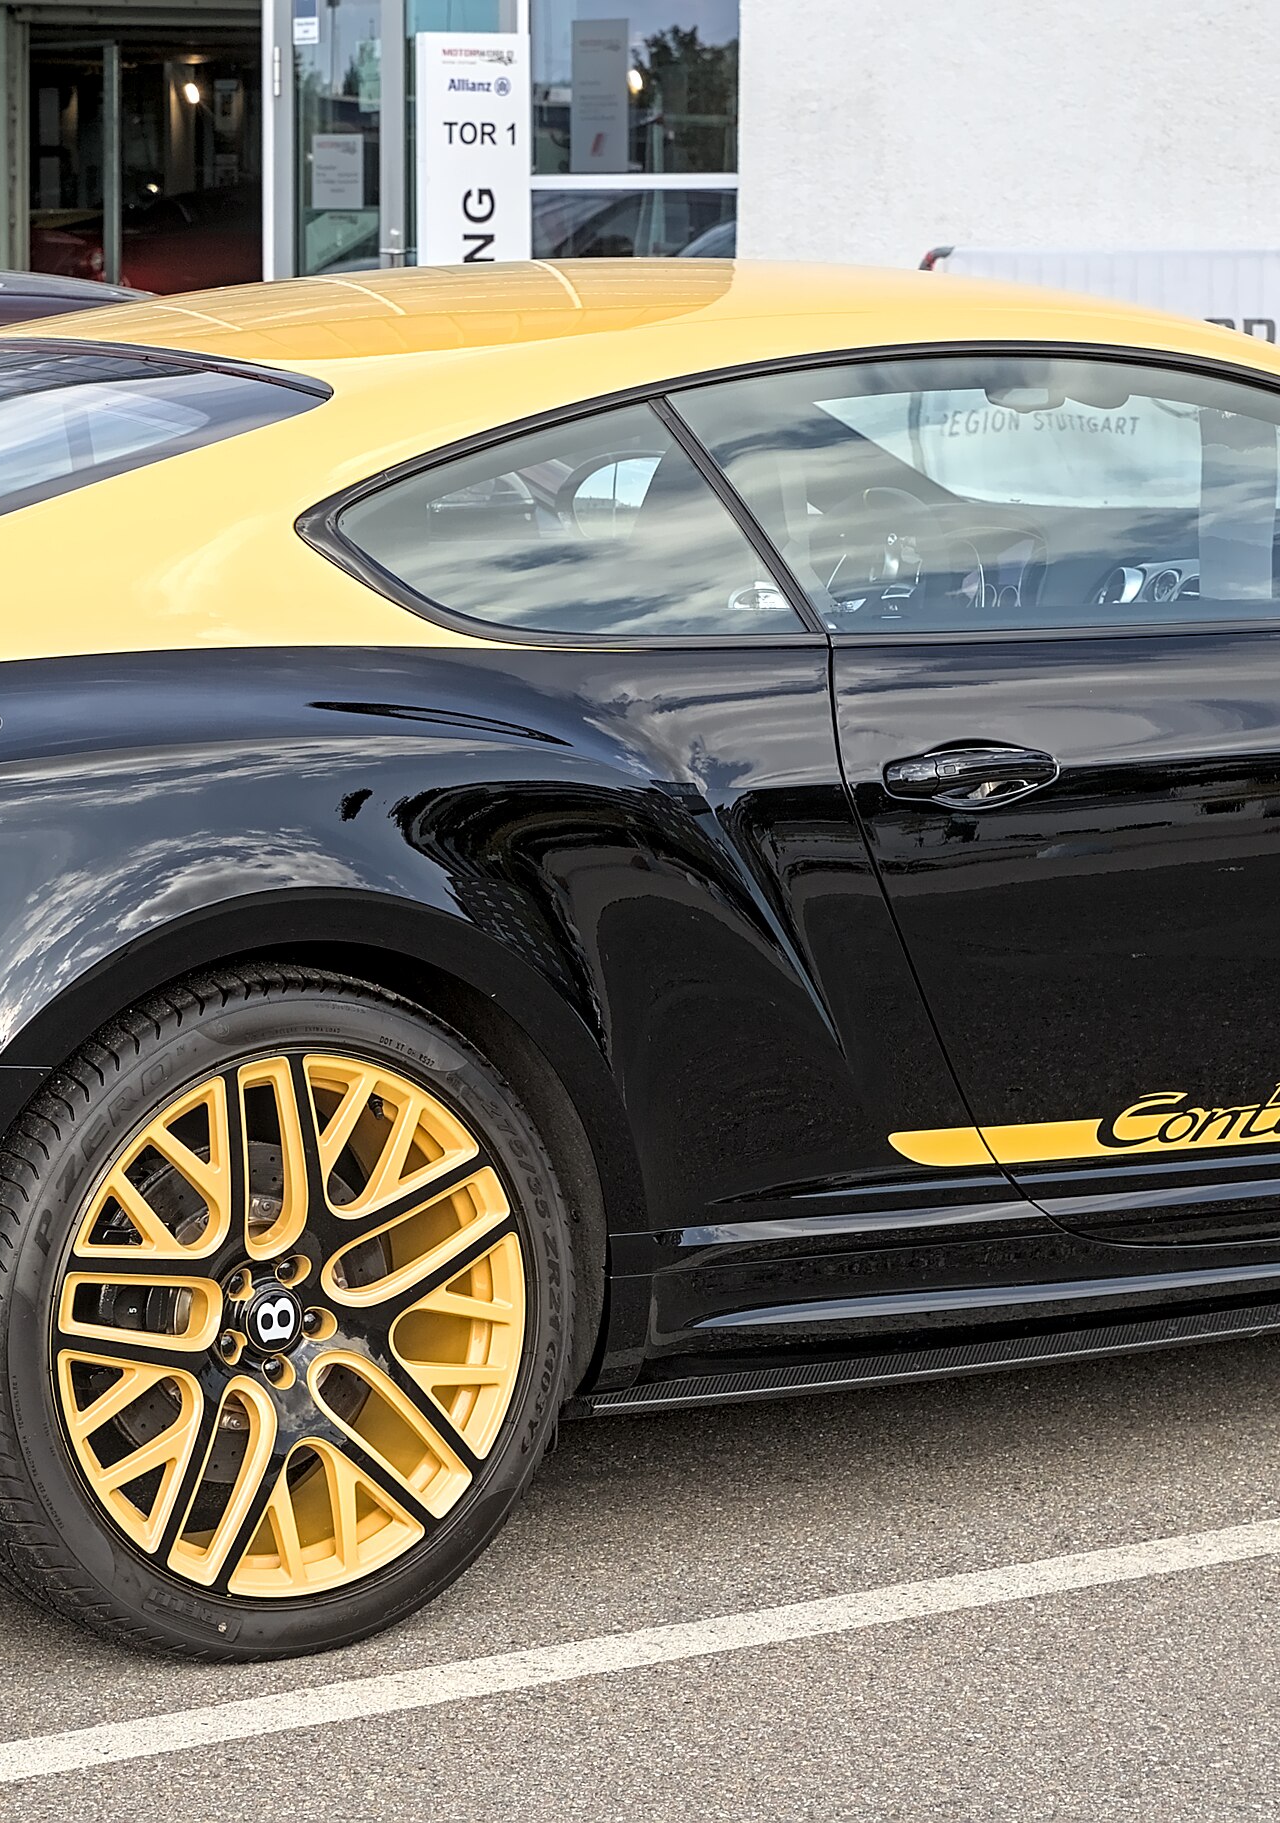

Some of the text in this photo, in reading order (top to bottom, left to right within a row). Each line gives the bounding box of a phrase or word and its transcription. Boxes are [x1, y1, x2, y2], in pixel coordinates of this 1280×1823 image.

[448, 79, 492, 93] Allianz
[443, 122, 516, 146] TOR 1
[1033, 414, 1141, 436] STUTTGART
[256, 1296, 296, 1344] B
